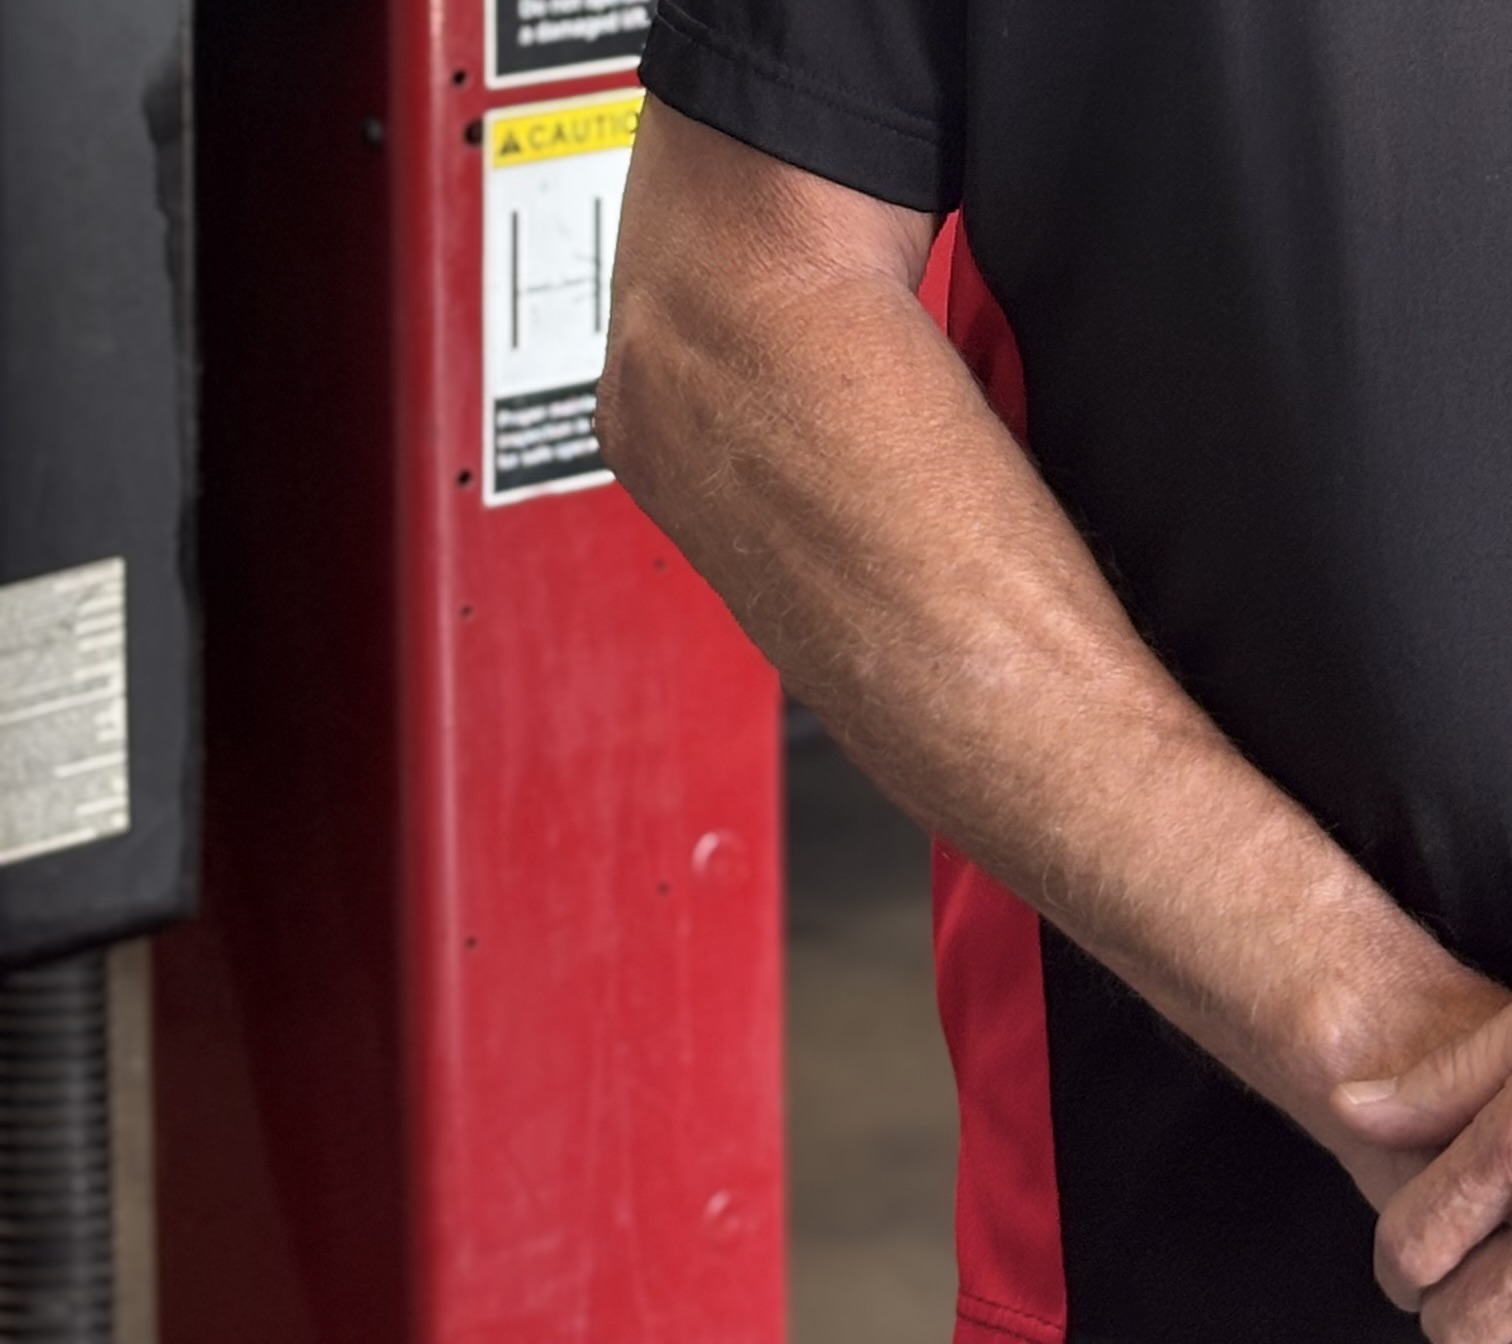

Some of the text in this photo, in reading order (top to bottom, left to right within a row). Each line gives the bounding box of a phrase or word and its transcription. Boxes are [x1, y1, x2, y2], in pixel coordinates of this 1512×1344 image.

[518, 25, 533, 47] a
[535, 11, 620, 43] damaged
[529, 112, 640, 150] CAUTIO
